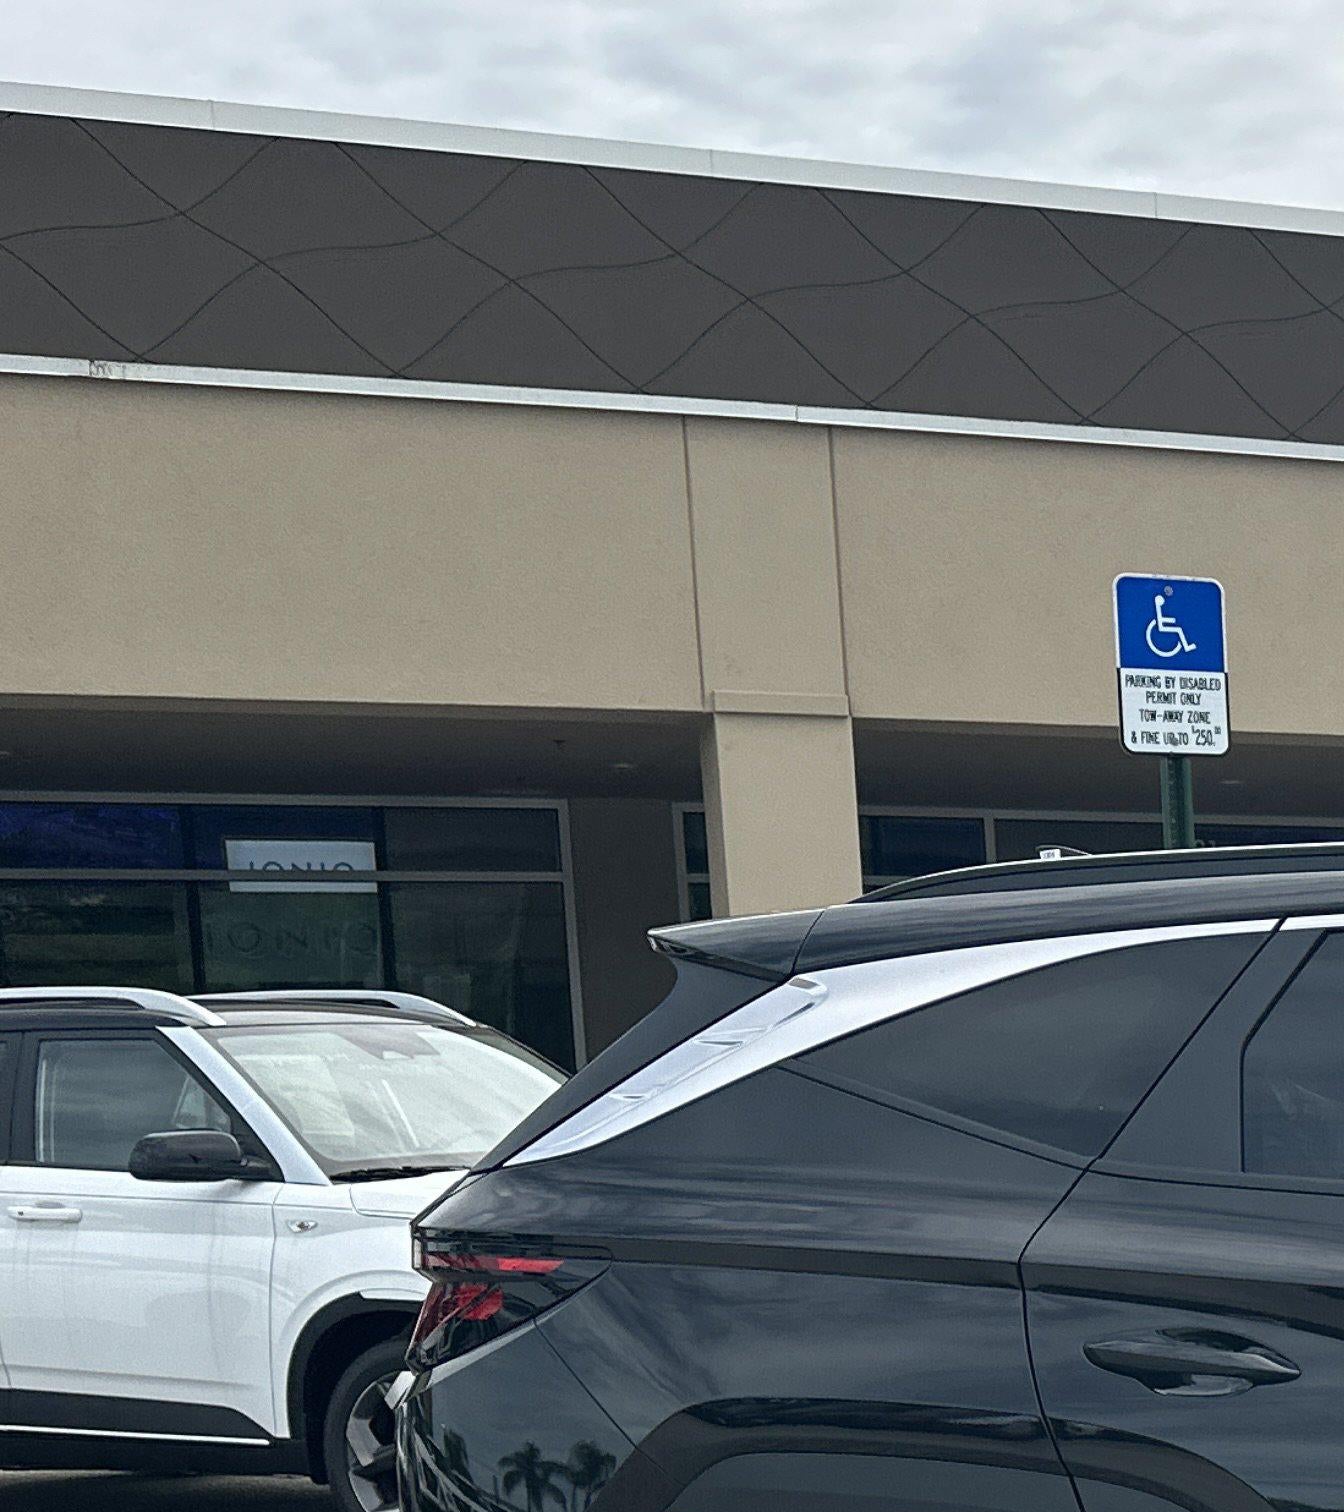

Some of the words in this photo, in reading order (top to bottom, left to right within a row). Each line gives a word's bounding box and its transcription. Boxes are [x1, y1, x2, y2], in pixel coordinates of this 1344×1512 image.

[1125, 674, 1161, 689] PARKING
[1165, 676, 1176, 689] BY
[1180, 677, 1221, 691] DISABLED
[1146, 691, 1177, 704] PERMIT
[1180, 692, 1202, 705] ONLY
[1139, 709, 1183, 723] TOW-AWAY
[1187, 711, 1211, 724] ZONE
[1140, 731, 1160, 744] FINE
